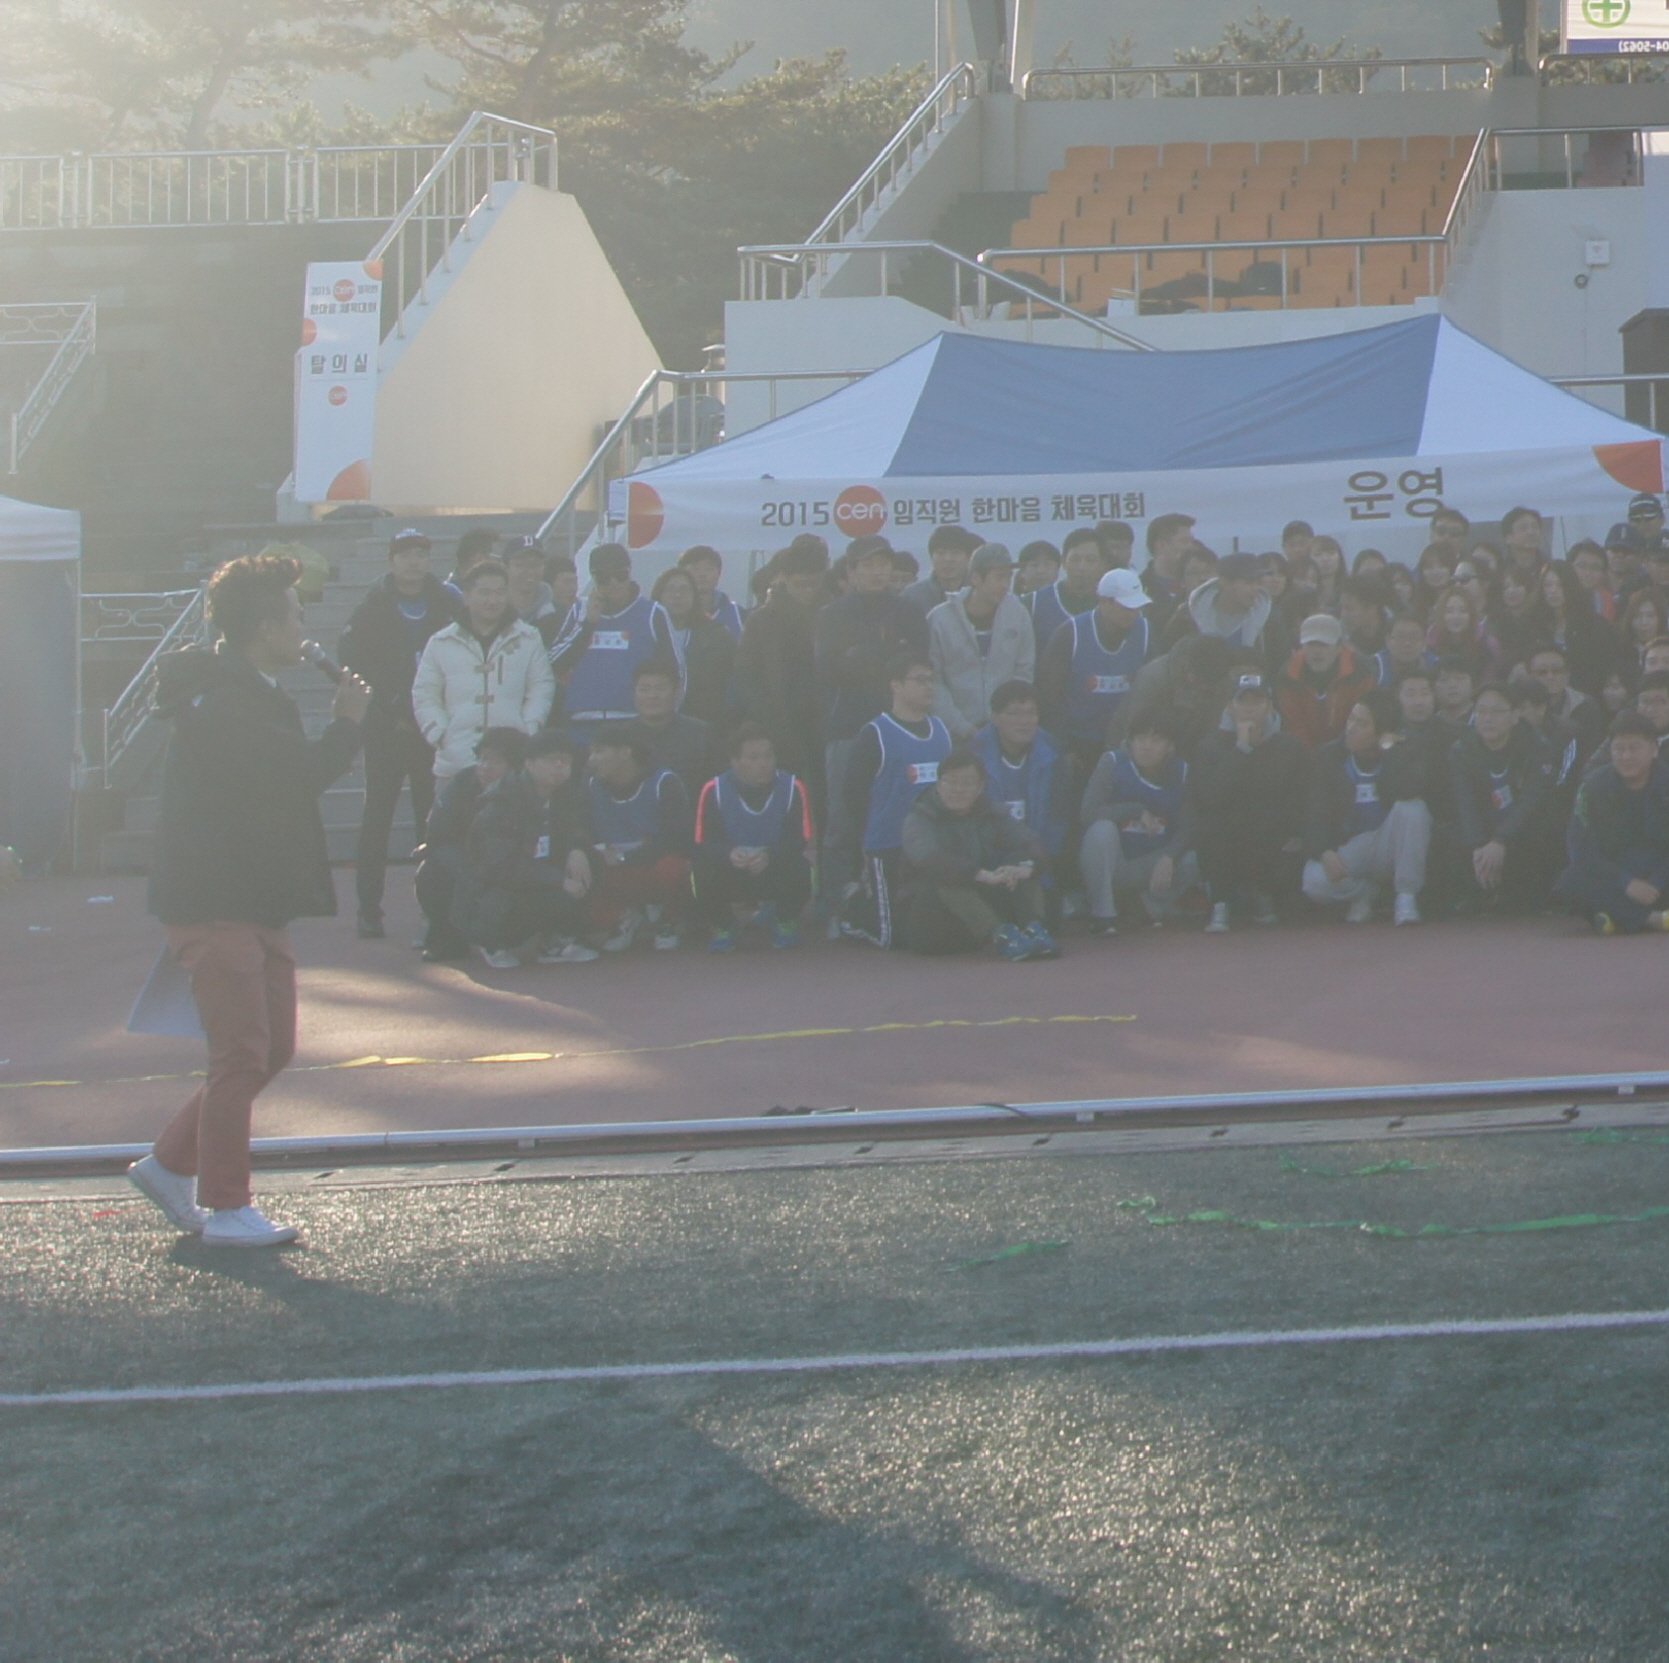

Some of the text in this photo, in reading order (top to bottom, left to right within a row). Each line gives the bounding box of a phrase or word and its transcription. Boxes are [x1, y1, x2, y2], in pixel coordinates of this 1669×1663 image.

[761, 500, 830, 528] 2015
[893, 498, 963, 526] 임직원
[971, 495, 1041, 524] 한마음
[1052, 491, 1147, 522] 체육대회
[1343, 466, 1445, 521] 운영
